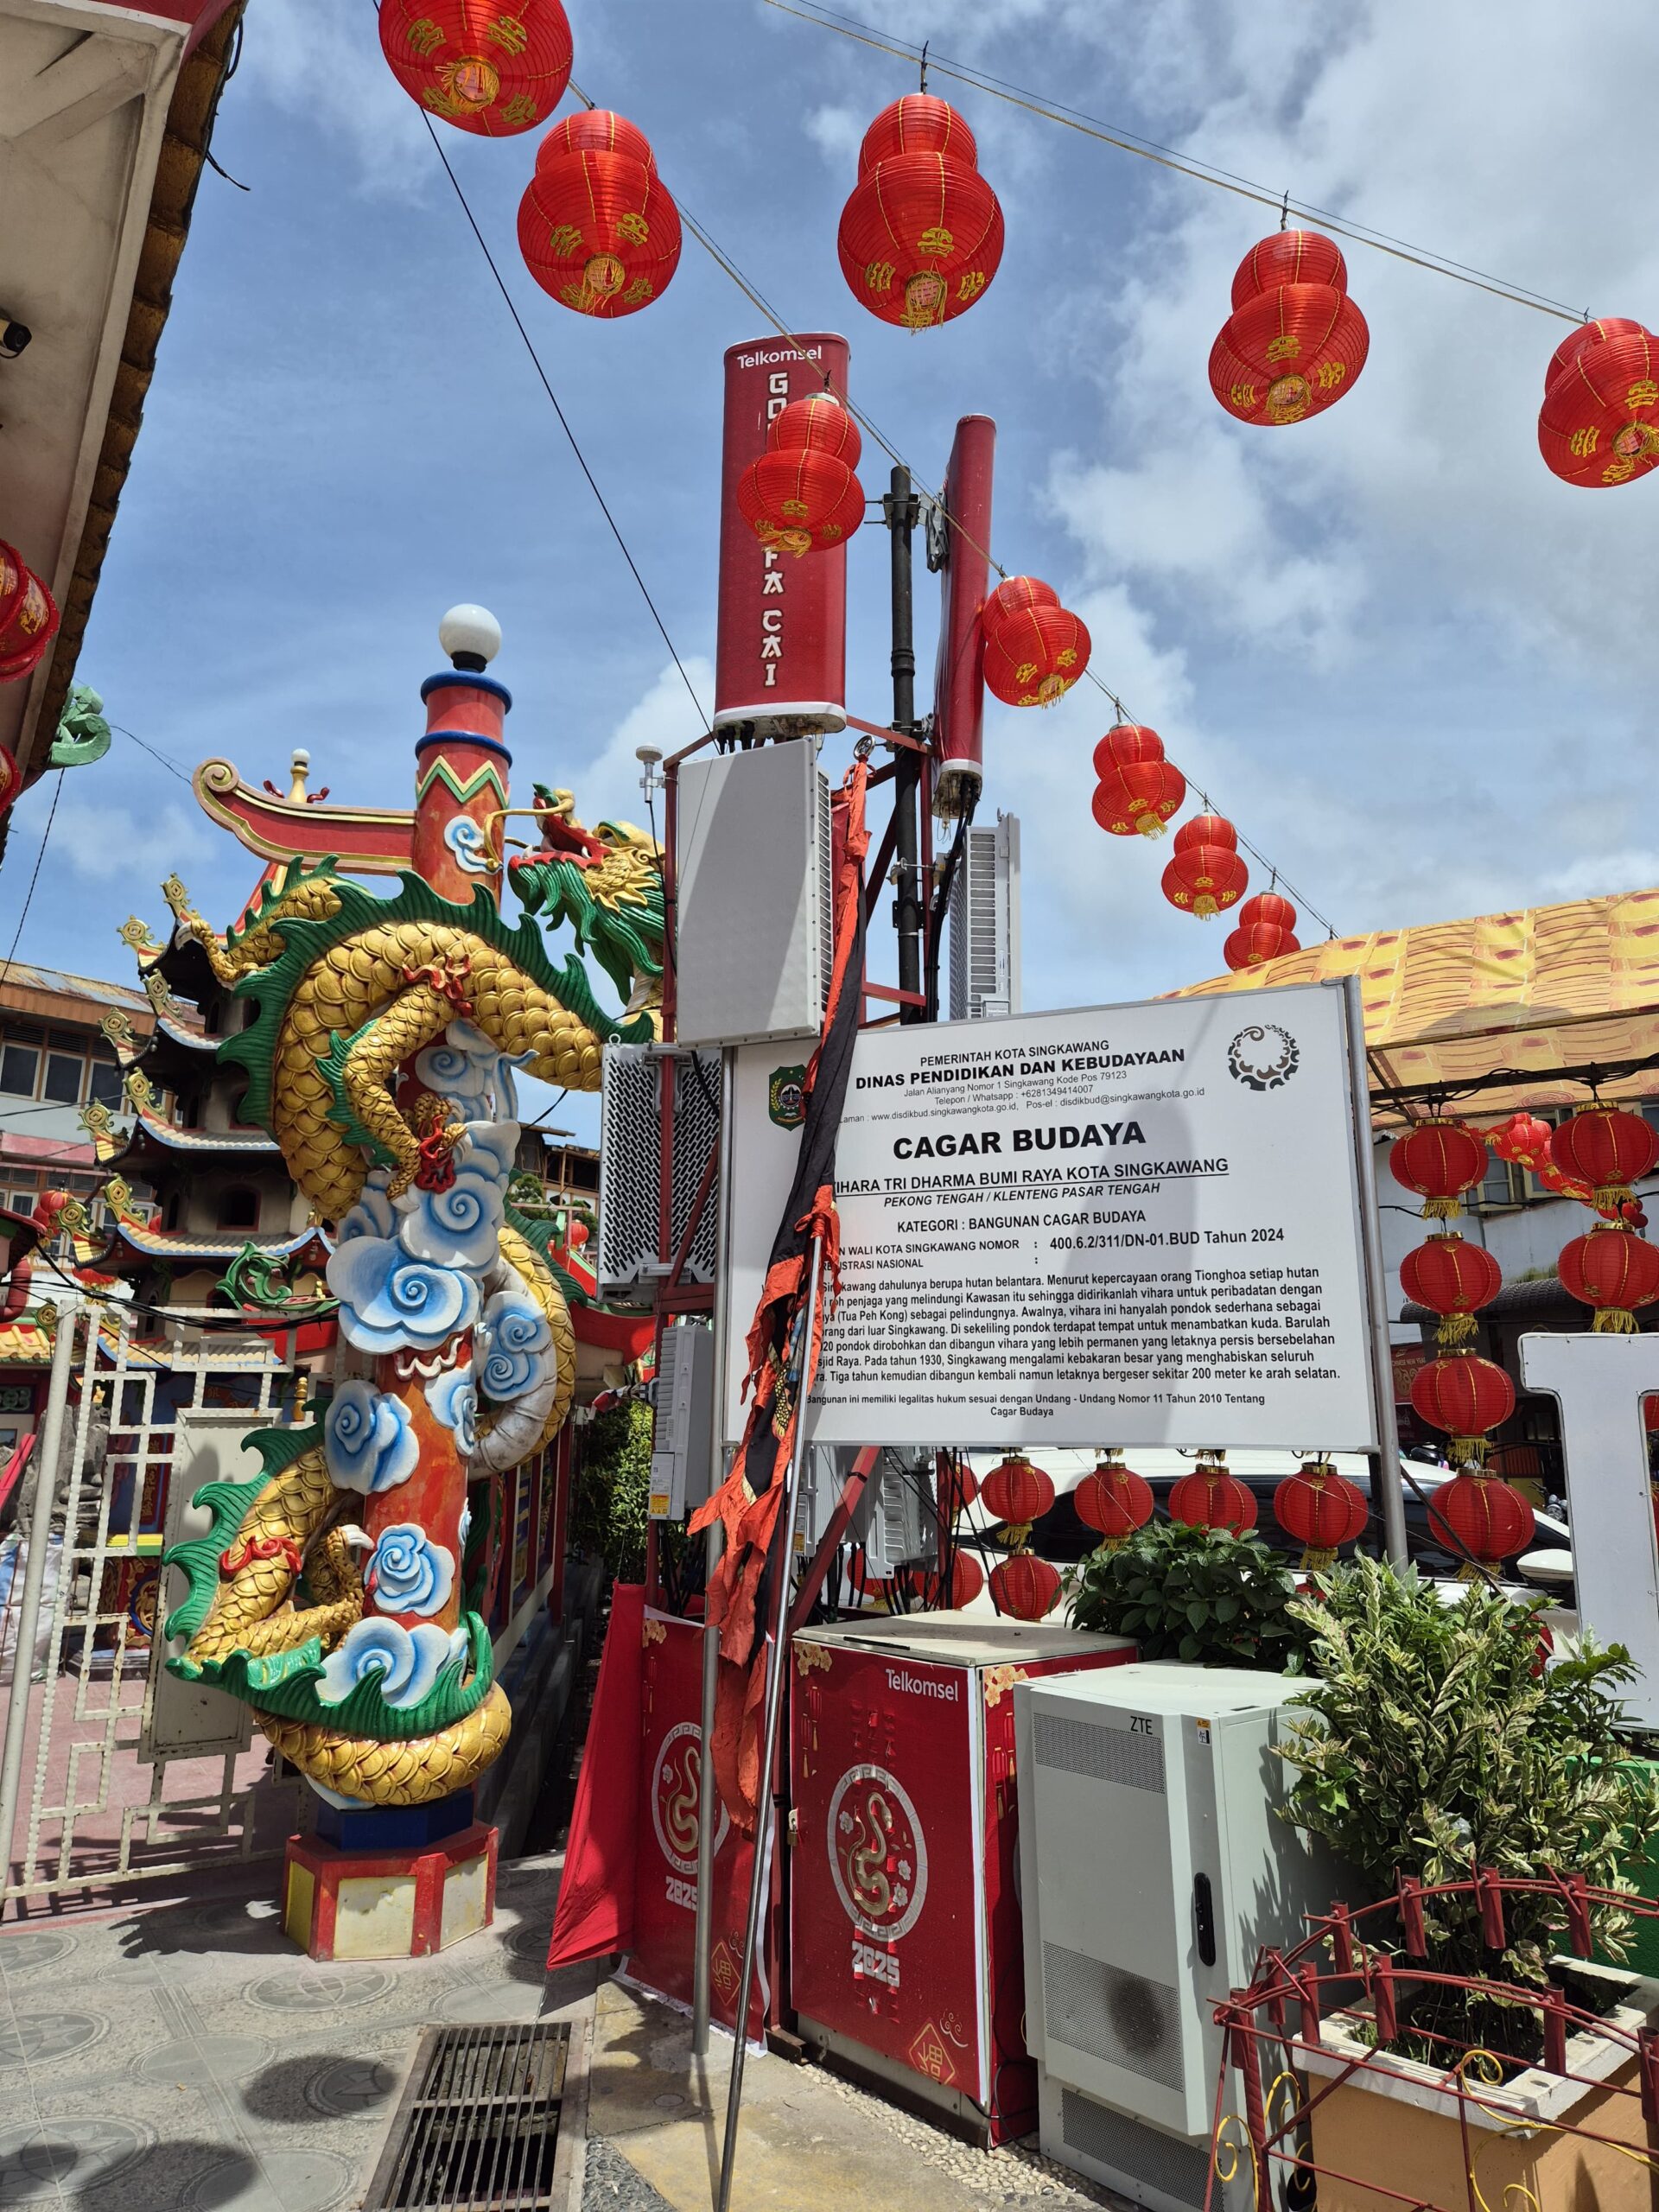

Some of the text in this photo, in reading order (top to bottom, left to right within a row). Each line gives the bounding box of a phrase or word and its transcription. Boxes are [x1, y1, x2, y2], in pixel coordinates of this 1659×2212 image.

[737, 346, 823, 370] Telkomsel
[762, 609, 785, 687] CAI
[920, 1040, 1109, 1067] PEMERINTAH KOTA SINGKAWANG
[856, 1048, 1184, 1090] DINAS PENDIDIKAN DAN KEBUDAYAAN
[904, 1089, 925, 1097] Jalan
[926, 1086, 964, 1096] Alianyang
[1004, 1078, 1053, 1090] Singkawang
[1057, 1075, 1077, 1084] Kode
[1081, 1073, 1097, 1082] Pos
[1100, 1071, 1127, 1080] 79123
[934, 1084, 1092, 1106] Telepon Whatsapp +6281349414007
[1027, 1100, 1052, 1109] Pos-el
[1059, 1087, 1205, 1106] disdikbud@singkawangkota.go.id
[893, 1122, 1146, 1160] CAGAR BUDAYA
[884, 1178, 906, 1191] TRI
[912, 1173, 975, 1189] DHARMA
[980, 1171, 1016, 1185] BUMI
[1022, 1168, 1062, 1183] RAYA
[1067, 1165, 1109, 1180] KOTA
[1115, 1158, 1227, 1178] SINGKAWANG
[884, 1182, 1160, 1207] PEKONG TENGAH KLENTENG PASAR TENGAH
[898, 1210, 1146, 1233] KATEGORI BANGUNAN CAGAR BUDAYA
[849, 1246, 872, 1255] WALI
[876, 1244, 902, 1255] KOTA
[906, 1241, 976, 1253] SINGKAWANG
[979, 1239, 1019, 1250] NOMOR
[1050, 1231, 1199, 1249] 400.6.2/311/DN-01.BUD
[1204, 1230, 1246, 1243] Tahun
[1251, 1228, 1284, 1242] 2024
[876, 1259, 923, 1268] NASIONAL
[879, 1280, 926, 1292] dahulunya
[930, 1279, 962, 1291] berupa
[966, 1277, 992, 1287] hutan
[995, 1276, 1043, 1287] belantara.
[1047, 1274, 1089, 1285] Menurut
[1091, 1273, 1157, 1286] kepercayaan
[1160, 1273, 1191, 1284] orang
[1194, 1269, 1246, 1283] Tionghoa
[1249, 1268, 1282, 1281] setiap
[1287, 1267, 1319, 1278] hutan
[847, 1283, 1322, 1309] penjaga melindungi Kawasan sehingga didirikanlah vihara untuk peribadatan dengan
[838, 1310, 856, 1324] (Tua
[860, 1310, 876, 1321] Peh
[880, 1309, 907, 1323] Kong)
[911, 1308, 946, 1322] sebagai
[950, 1307, 1018, 1321] pelindungnya.
[1021, 1306, 1065, 1319] Awalnya,
[1069, 1305, 1100, 1316] vihara
[1120, 1303, 1166, 1318] hanyalah
[1171, 1302, 1211, 1317] pondok
[1215, 1301, 1272, 1313] sederhana
[1276, 1300, 1320, 1314] sebagai
[848, 1316, 1329, 1338] dari luar Singkawang. sekeliling pondok terdapat tempat untuk menambatkan kuda. Barulah
[836, 1332, 1334, 1354] pondok dirobohkan dibangun vihara yang permanen letaknya persis bersebelahan
[836, 1350, 1313, 1369] Raya. Pada tahun 1930, Singkawang mengalami kebakaran besar menghabiskan seluruh
[830, 1370, 849, 1384] Tiga
[852, 1370, 878, 1382] tahun
[881, 1370, 926, 1381] kemudian
[930, 1370, 974, 1383] dibangun
[978, 1370, 1015, 1381] kembali
[1020, 1371, 1052, 1380] namun
[1057, 1369, 1099, 1382] letaknya
[1103, 1368, 1149, 1382] bergeser
[1153, 1368, 1188, 1379] sekitar
[1192, 1367, 1211, 1379] 200
[1215, 1368, 1246, 1379] meter
[1294, 1367, 1339, 1379] selatan.
[861, 1395, 895, 1403] memiliki
[899, 1395, 933, 1406] legalitas
[937, 1394, 965, 1403] hukum
[969, 1394, 996, 1403] sesuai
[1000, 1394, 1033, 1406] dengan
[1035, 1394, 1071, 1406] Undang
[1079, 1394, 1115, 1406] Undang
[1118, 1394, 1150, 1403] Nomor
[1154, 1394, 1161, 1402] 11
[1166, 1393, 1196, 1403] Tahun
[1199, 1394, 1221, 1403] 2010
[1224, 1394, 1264, 1406] Tentang
[990, 1407, 1053, 1418] Cagar Budaya
[886, 1669, 958, 1702] Telkomsel
[1130, 1715, 1153, 1735] ZTE
[852, 1940, 899, 1987] 2025
